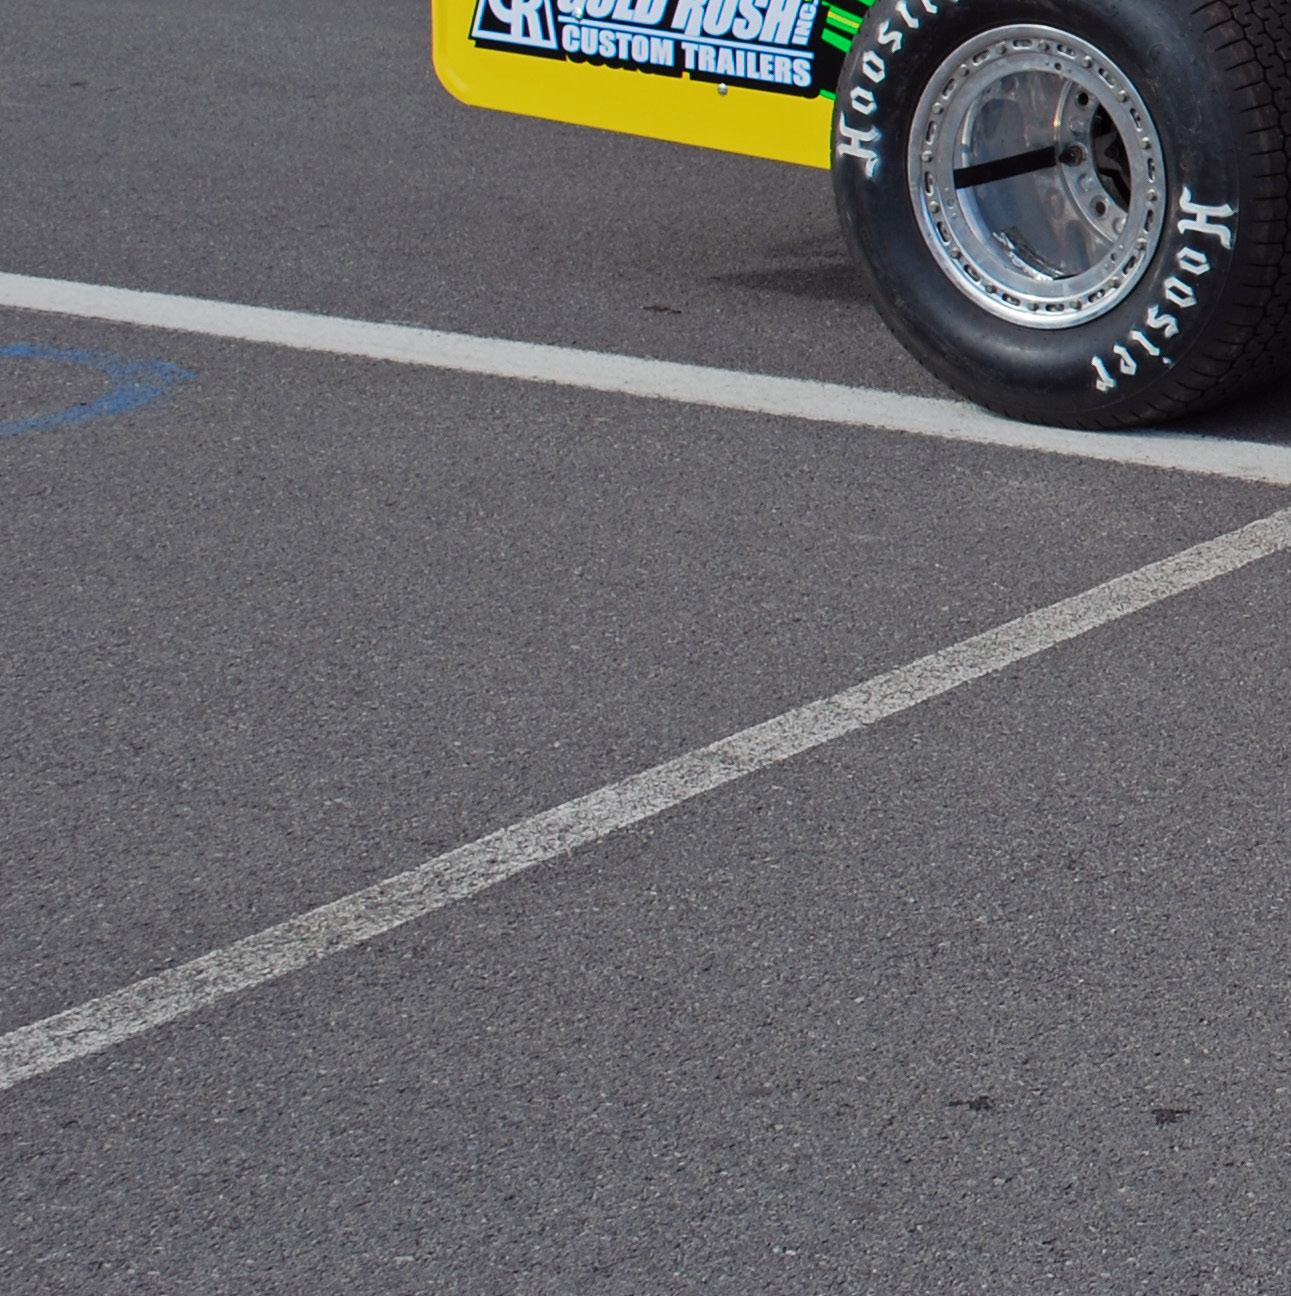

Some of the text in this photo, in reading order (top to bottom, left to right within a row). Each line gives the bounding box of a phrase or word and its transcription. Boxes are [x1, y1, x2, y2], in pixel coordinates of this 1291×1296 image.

[562, 24, 813, 88] CUSTOM TRAILERS
[1091, 186, 1238, 394] Hoosier
